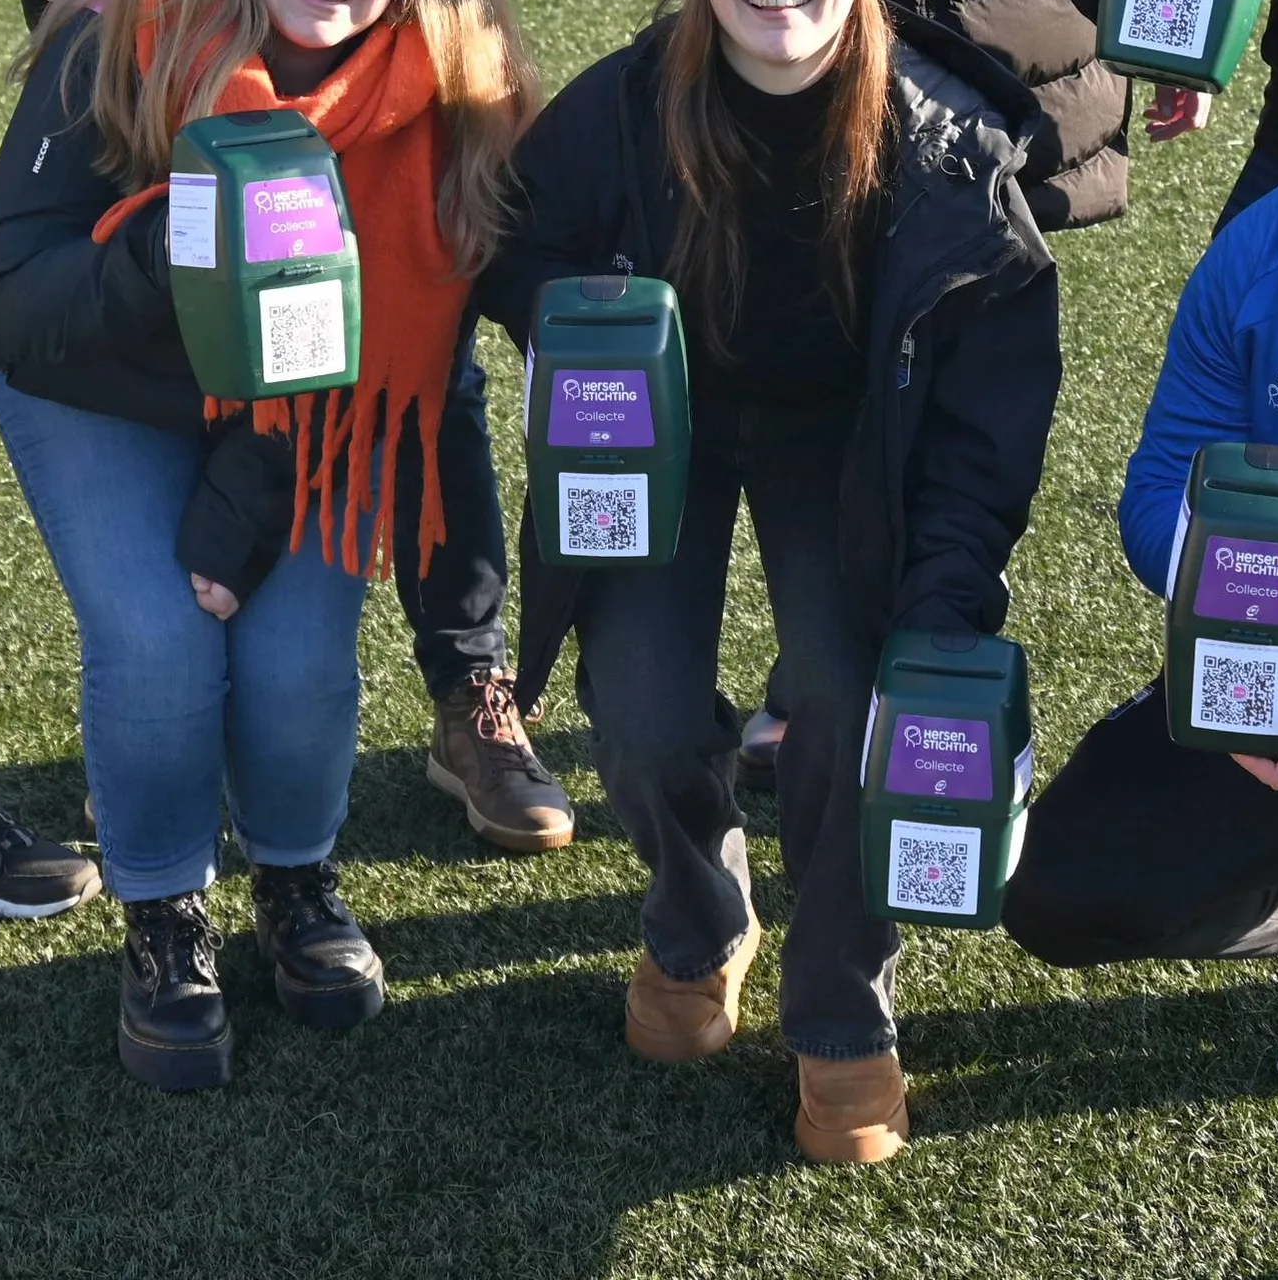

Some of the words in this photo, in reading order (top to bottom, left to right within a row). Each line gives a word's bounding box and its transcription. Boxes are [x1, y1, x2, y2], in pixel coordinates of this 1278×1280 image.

[270, 220, 317, 234] Collecte
[582, 381, 625, 392] Hersen
[582, 391, 637, 402] STICHTING
[576, 411, 625, 422] Collecte
[1226, 582, 1278, 598] Collecte
[923, 728, 966, 743] Hersen
[923, 739, 978, 754] STICHTING
[914, 758, 965, 773] Collecte
